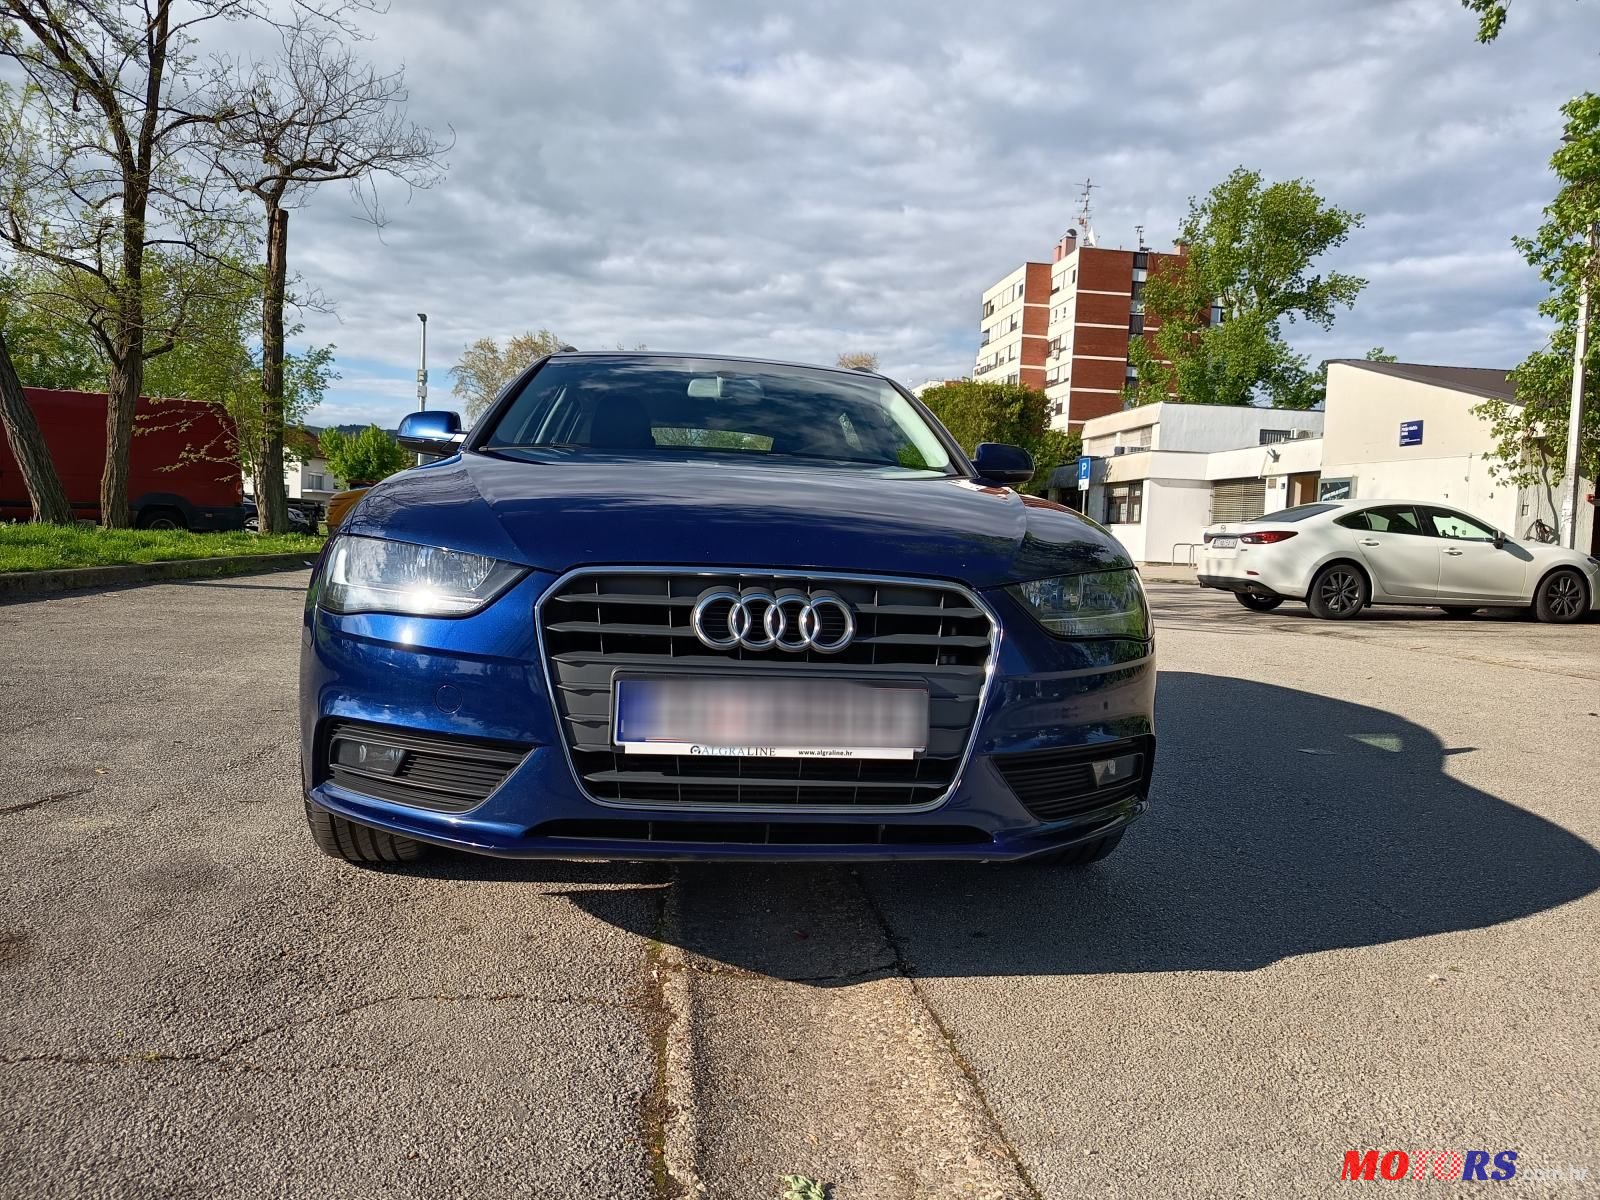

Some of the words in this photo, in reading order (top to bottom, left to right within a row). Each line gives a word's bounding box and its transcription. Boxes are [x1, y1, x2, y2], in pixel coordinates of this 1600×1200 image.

[1081, 462, 1087, 476] P
[702, 746, 776, 757] ALGRALINE
[798, 749, 853, 757] www.algraline.hr
